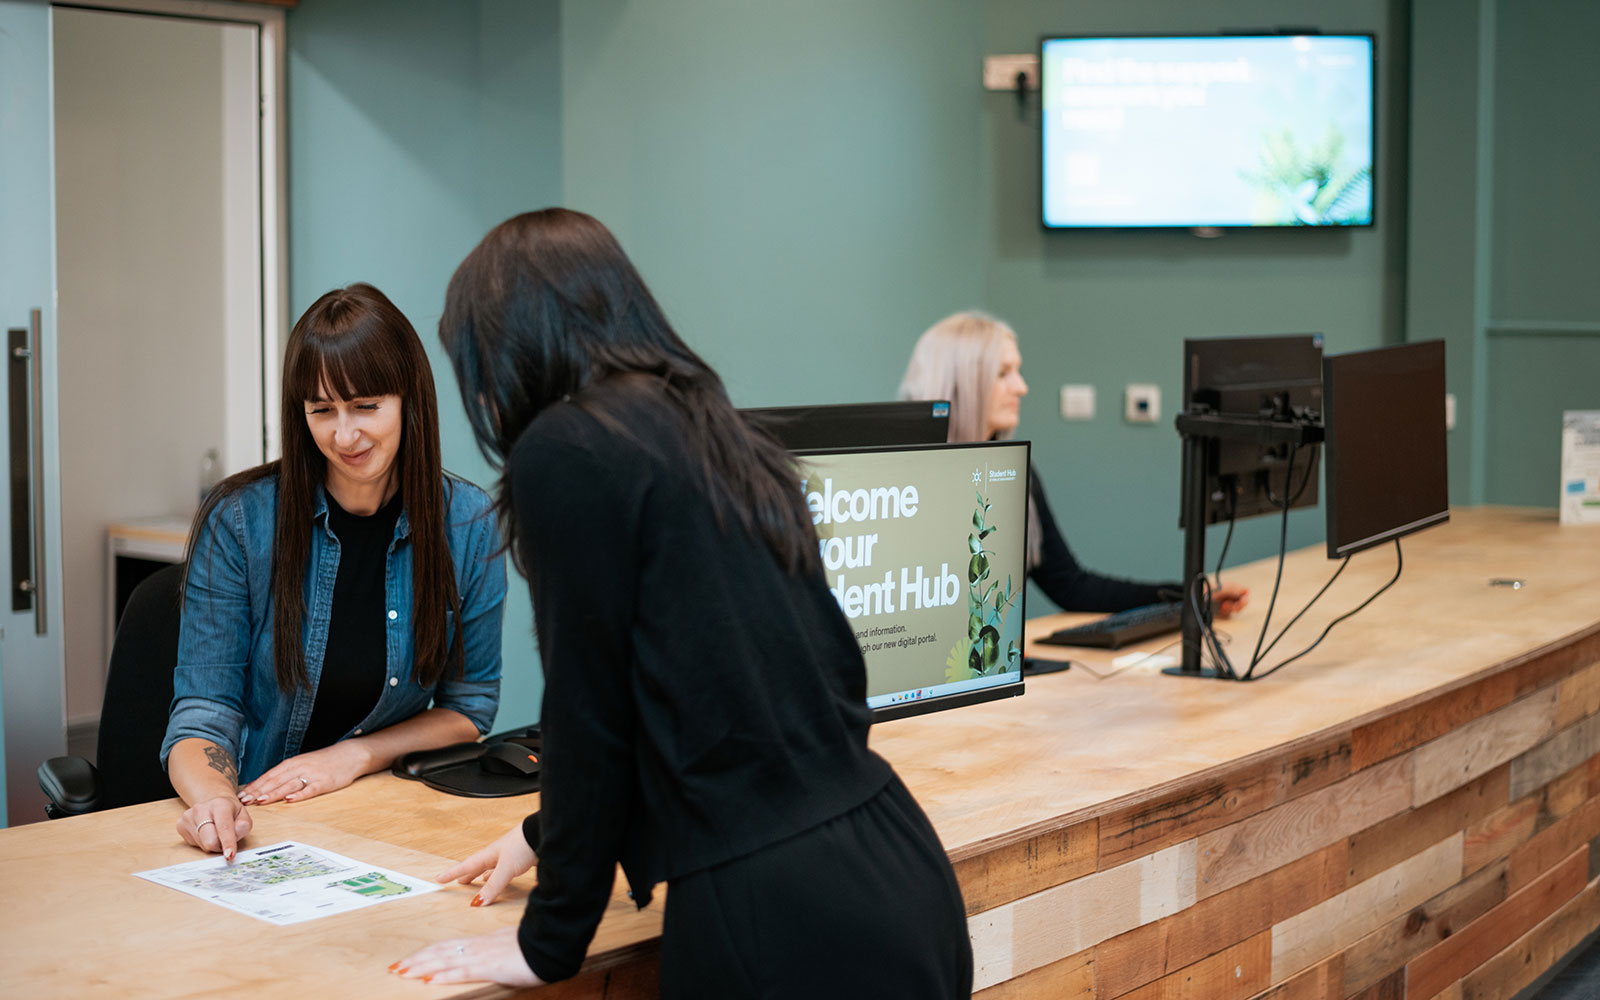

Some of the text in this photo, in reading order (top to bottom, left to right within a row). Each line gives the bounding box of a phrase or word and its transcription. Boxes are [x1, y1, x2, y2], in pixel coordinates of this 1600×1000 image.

[801, 478, 919, 525] elcome
[829, 563, 960, 619] dent Hub
[856, 625, 906, 638] and information.
[872, 642, 883, 651] our
[884, 640, 897, 649] new
[898, 636, 917, 648] digital
[918, 633, 936, 646] portal.
